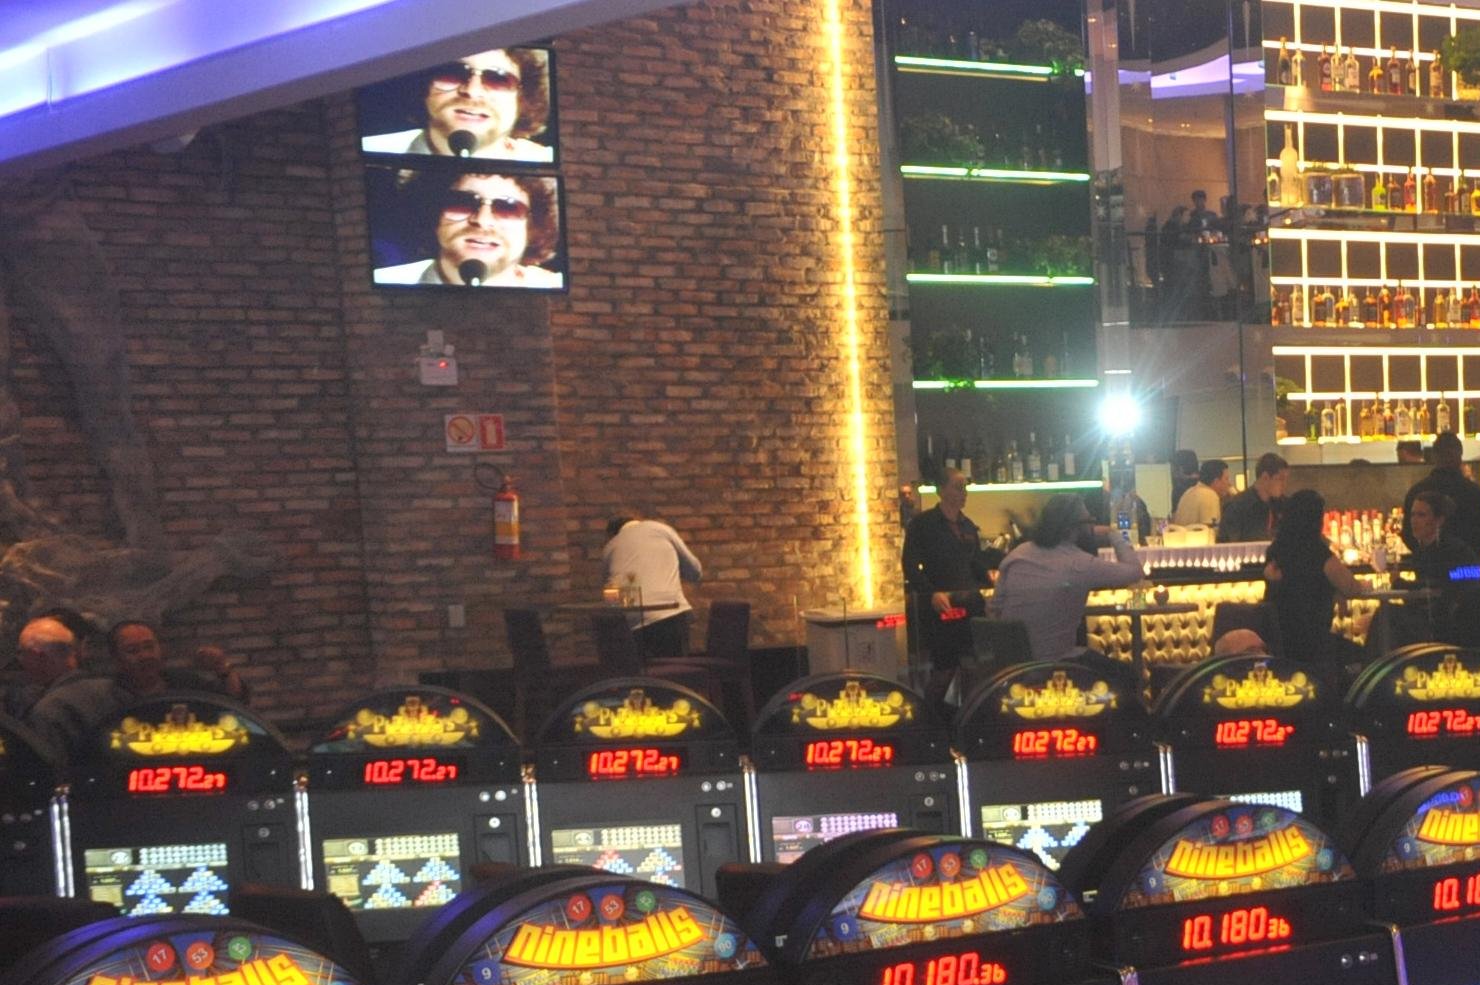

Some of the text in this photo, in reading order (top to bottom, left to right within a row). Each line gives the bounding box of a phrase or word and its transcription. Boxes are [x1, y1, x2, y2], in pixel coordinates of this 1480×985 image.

[1165, 825, 1312, 878] nineballs
[861, 863, 1028, 921] nineballs
[572, 900, 584, 914] 17
[504, 907, 705, 965] nineballs
[840, 922, 849, 935] 9
[152, 948, 168, 964] 17
[191, 947, 208, 963] 53
[481, 967, 493, 980] 9
